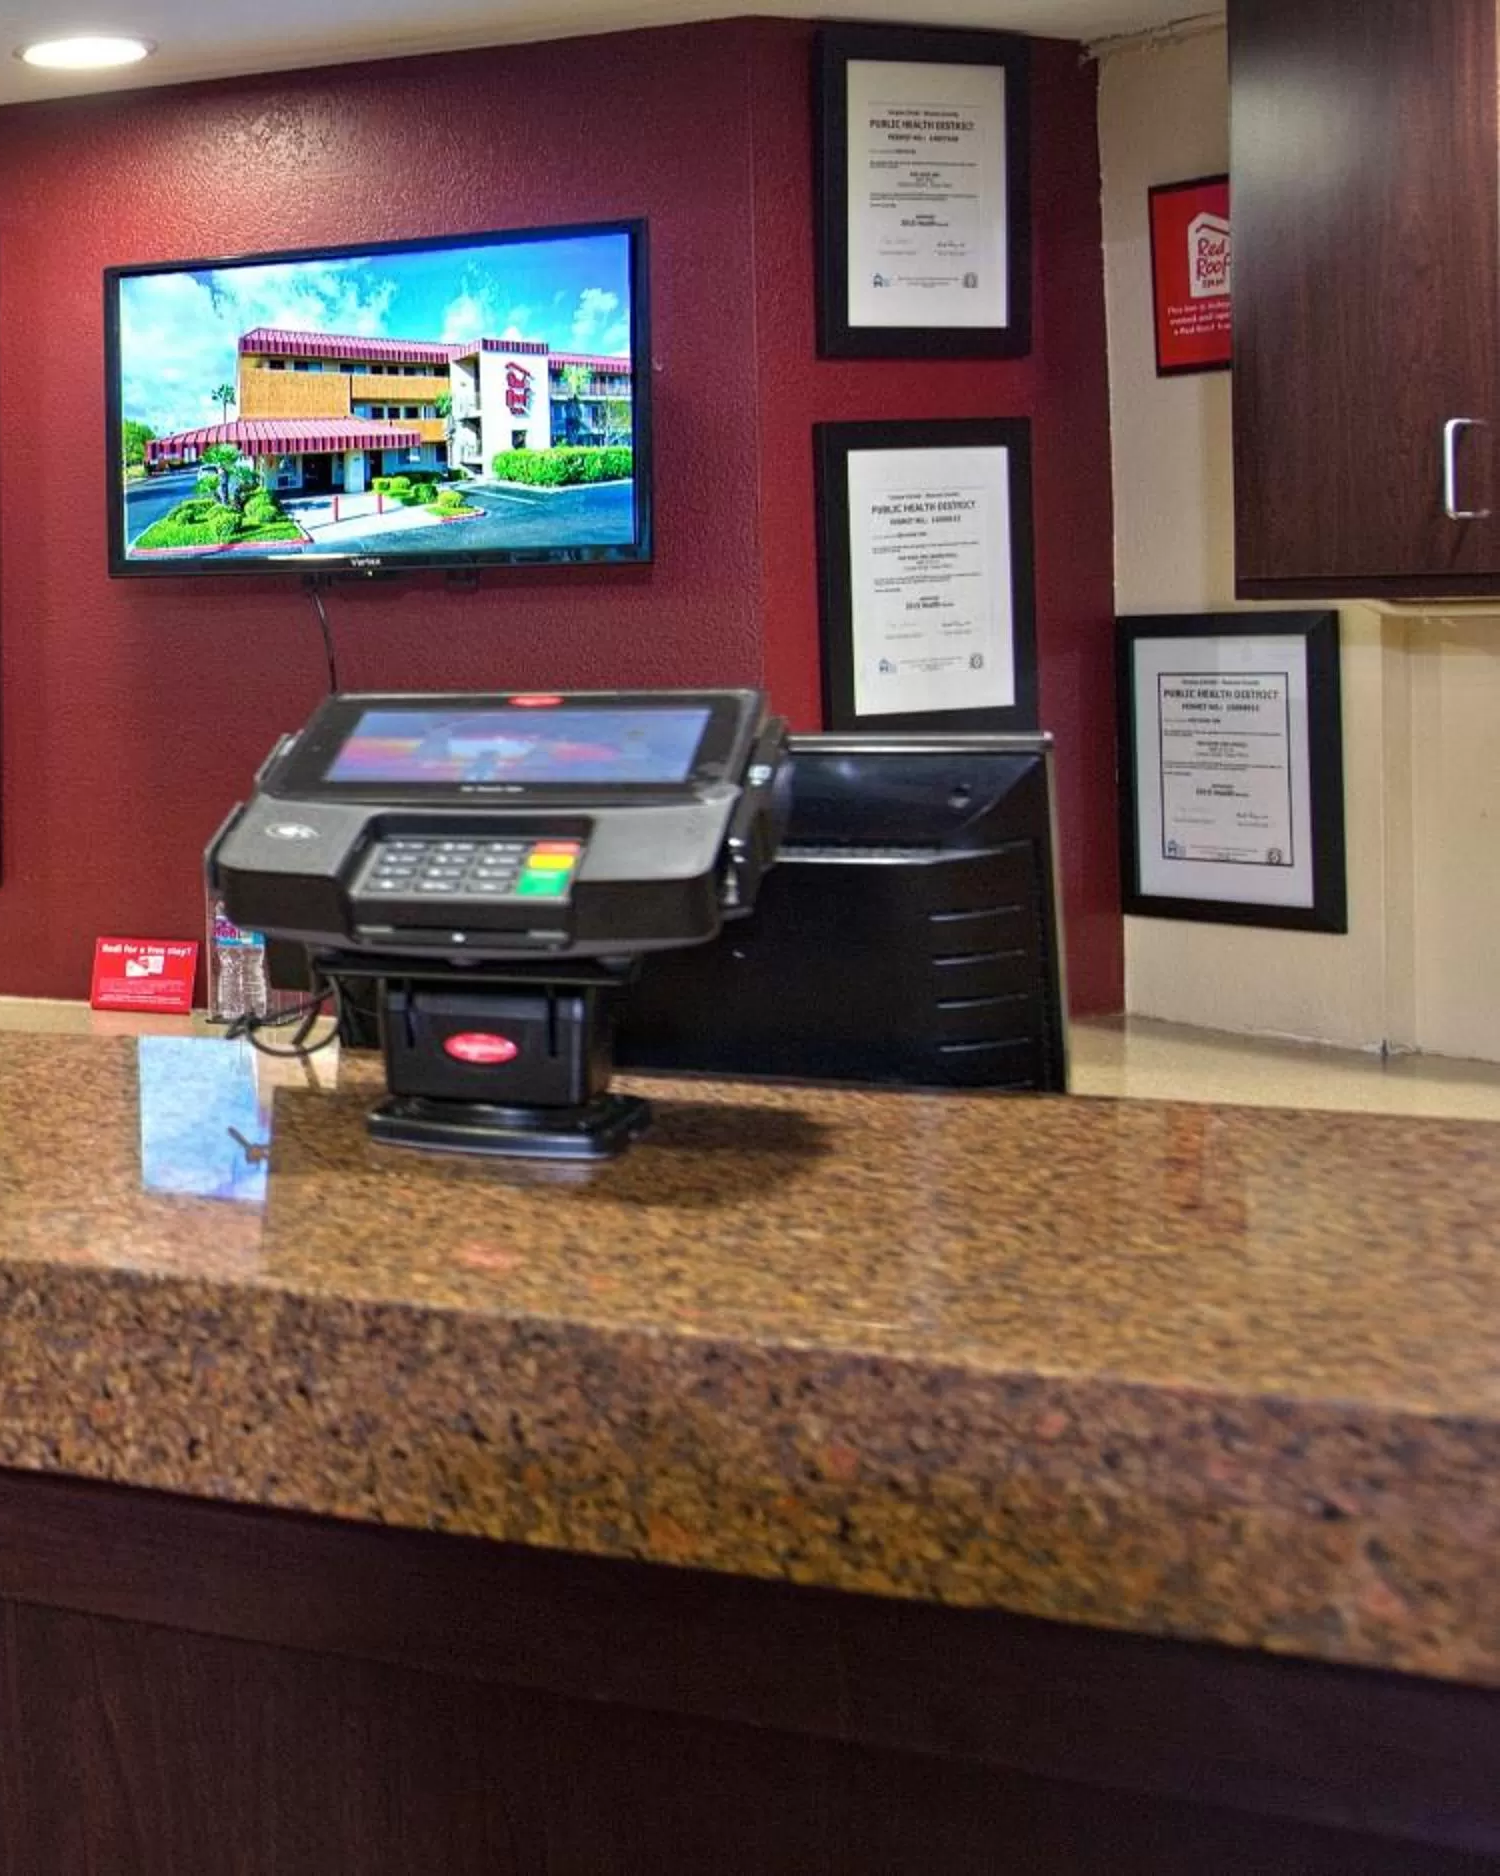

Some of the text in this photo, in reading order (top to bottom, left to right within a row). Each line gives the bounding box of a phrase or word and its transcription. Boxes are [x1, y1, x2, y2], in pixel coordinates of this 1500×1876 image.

[869, 119, 976, 132] PUBLIC HEALTH DISTRICT
[1197, 238, 1225, 257] Red
[1195, 252, 1231, 281] Roof
[871, 500, 976, 515] PUBLIC HEALTH DISTRICT
[1163, 688, 1280, 701] PUBLIC HEALTH DISTRICT
